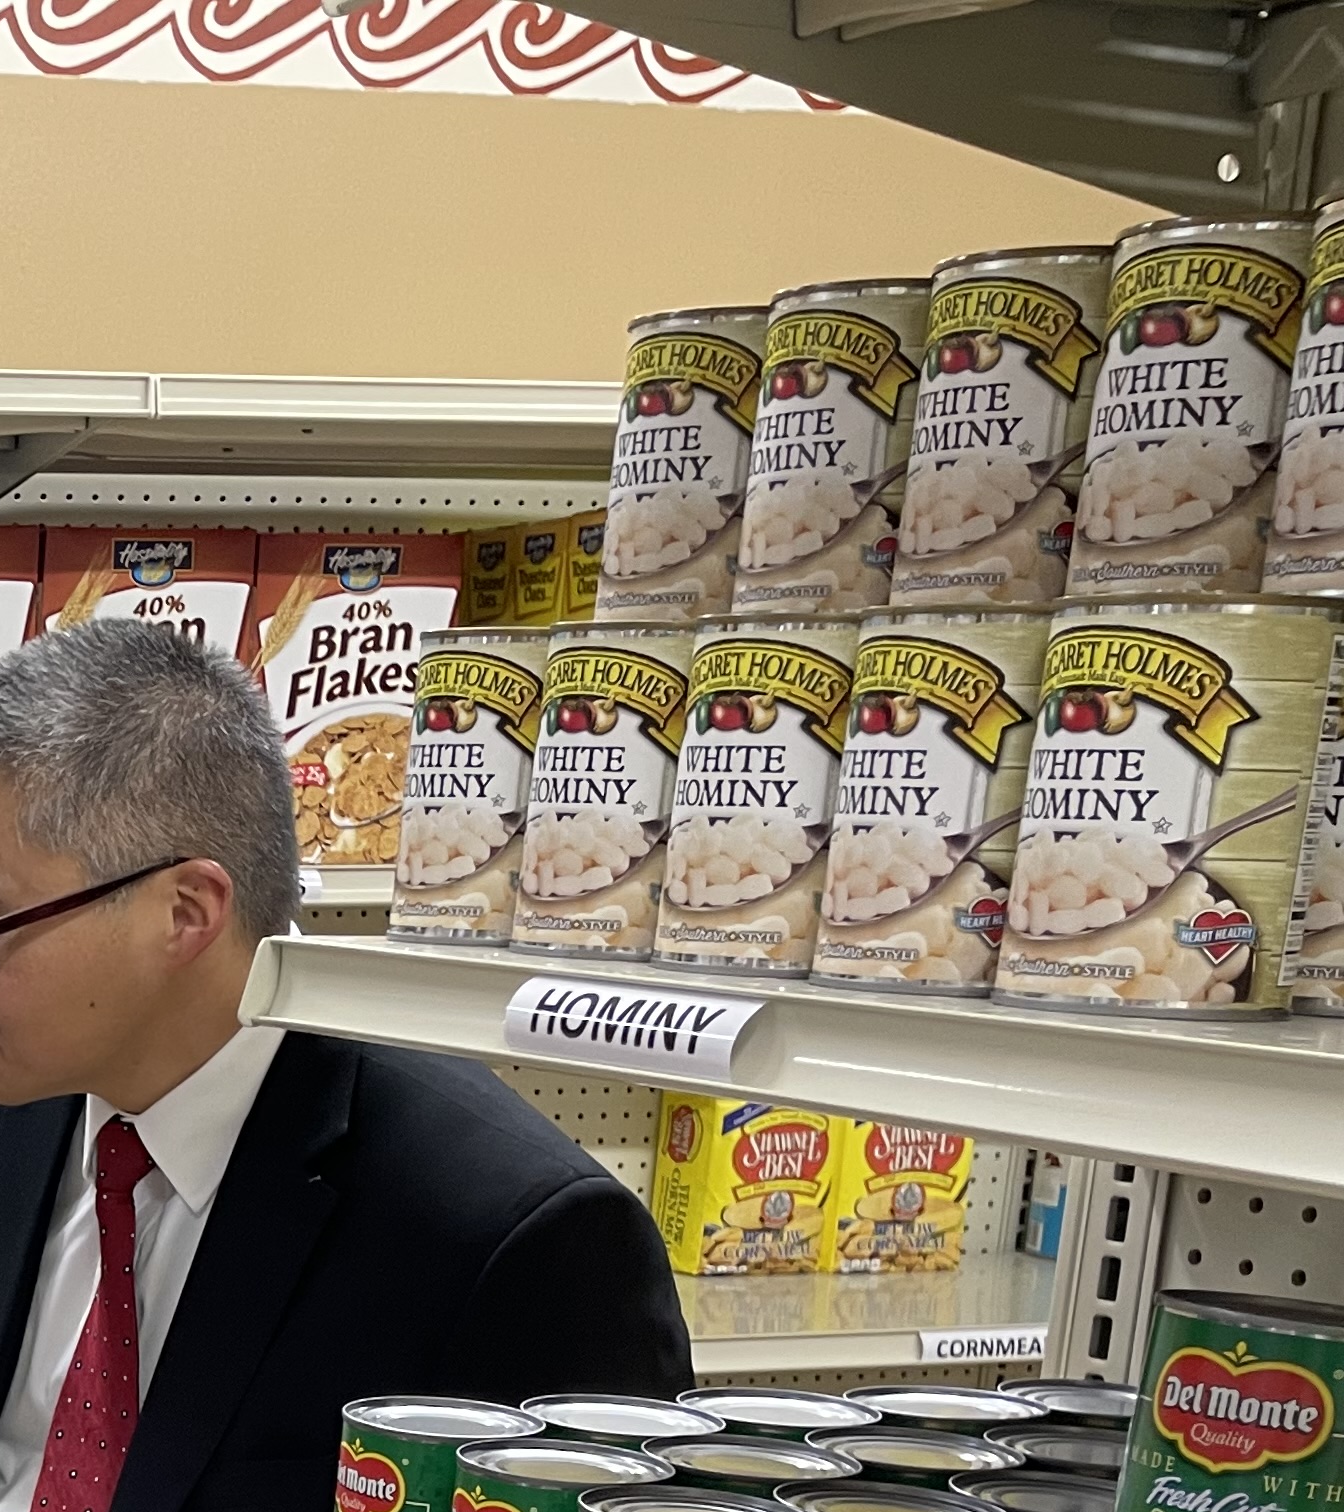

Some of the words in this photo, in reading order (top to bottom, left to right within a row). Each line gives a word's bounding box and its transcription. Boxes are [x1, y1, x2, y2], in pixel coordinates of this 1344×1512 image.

[1188, 256, 1290, 310] HOLMES
[1108, 357, 1229, 398] WHITE
[1093, 394, 1243, 438] HOMINY
[618, 425, 702, 455] WHITE
[1096, 561, 1160, 582] Southern
[133, 595, 185, 616] 40%
[343, 600, 392, 621] 40%
[308, 621, 412, 664] Bran
[456, 662, 532, 706] HOLMES
[594, 659, 677, 704] HOLMES
[747, 655, 841, 702] HOLMES
[892, 650, 987, 703] HOLMES
[1106, 641, 1213, 698] HOLMES
[286, 657, 420, 719] Flakes
[539, 746, 626, 772] WHITE
[686, 745, 786, 773] WHITE
[1033, 749, 1146, 781] WHITE
[676, 780, 799, 808] HOMINY
[1022, 788, 1160, 821] HOMINY
[581, 920, 621, 931] STYLE
[739, 932, 782, 943] STYLE
[961, 916, 990, 927] HEART
[1181, 930, 1212, 943] HEART
[1215, 926, 1255, 941] HEALTHY
[1015, 956, 1070, 976] Southern
[1082, 966, 1134, 979] STYLE
[530, 988, 726, 1054] HOMINY
[937, 1335, 1042, 1359] CORNMEA
[1163, 1375, 1202, 1414] Del
[1207, 1386, 1319, 1435] Monte
[1190, 1422, 1256, 1455] Quality
